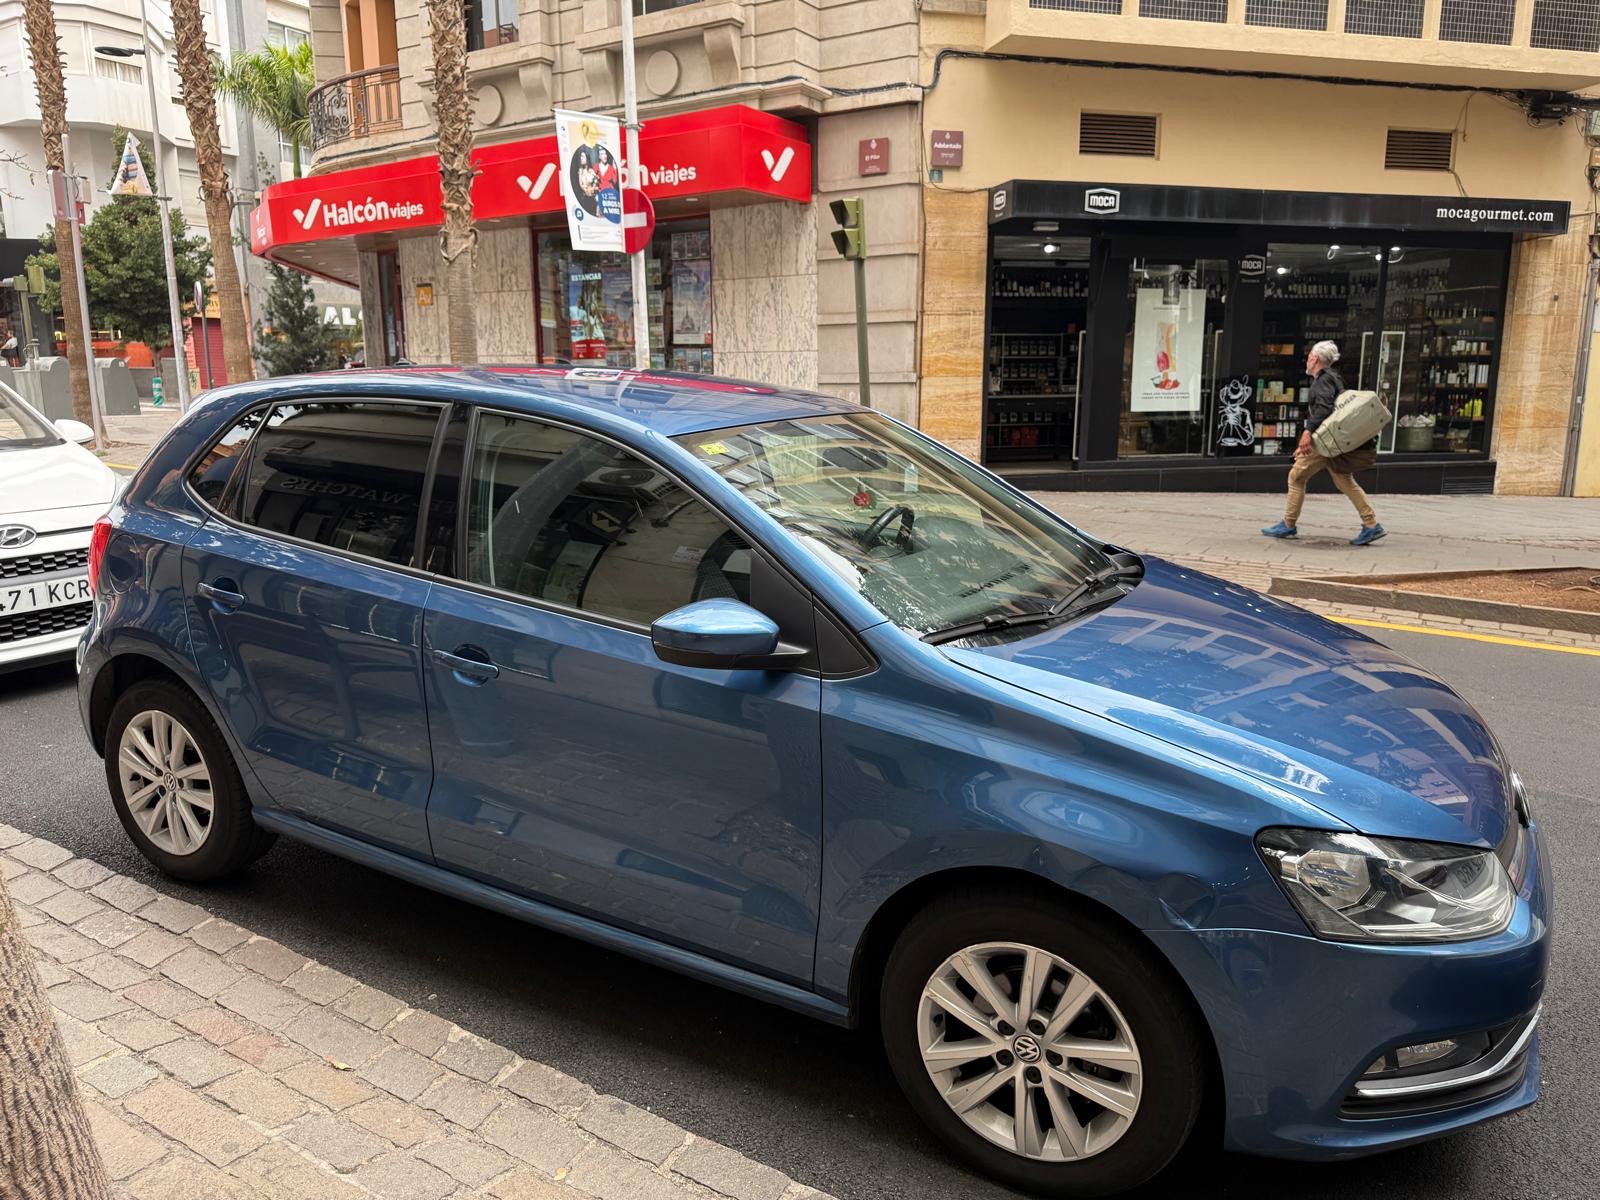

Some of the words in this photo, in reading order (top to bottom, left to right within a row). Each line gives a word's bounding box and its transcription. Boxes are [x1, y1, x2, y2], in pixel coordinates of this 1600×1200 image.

[651, 164, 697, 187] viajes
[1090, 195, 1115, 207] MOCA
[323, 197, 390, 228] Halcón
[390, 201, 424, 220] viajes
[1436, 207, 1554, 222] mocagourmet.com
[1242, 260, 1262, 270] MOCA
[571, 272, 602, 282] ESTANCIAS
[48, 579, 90, 604] KCR
